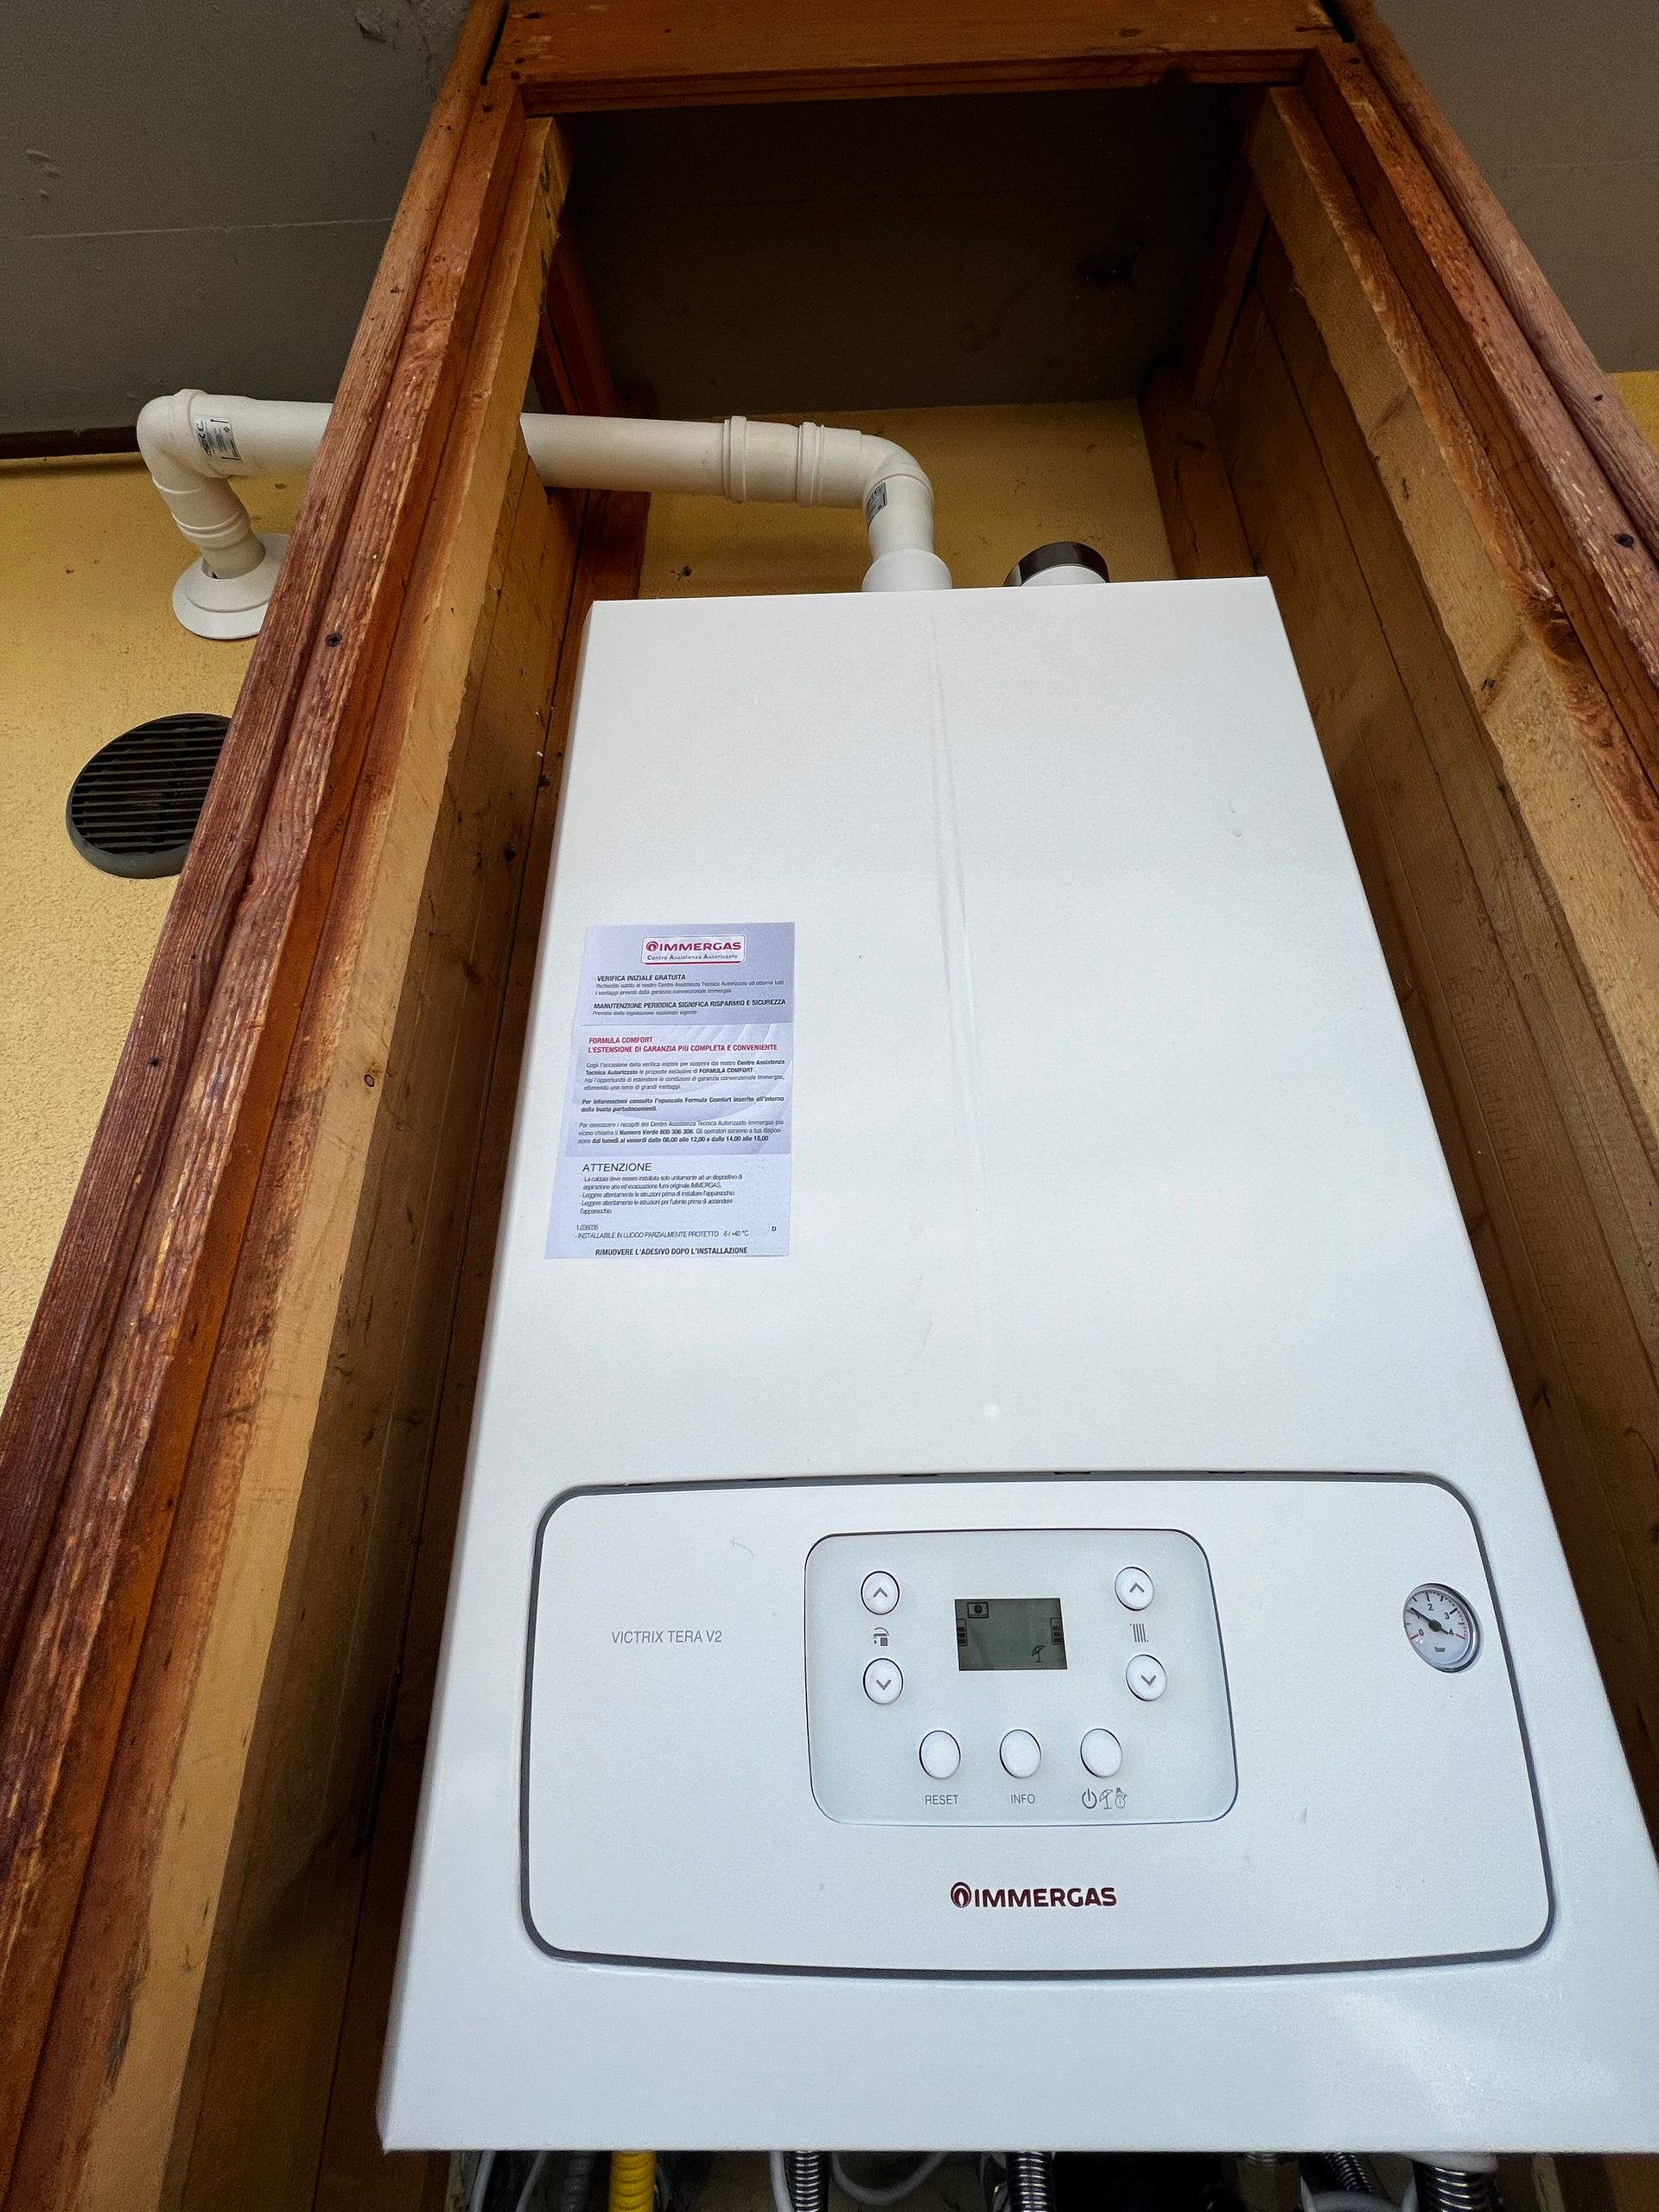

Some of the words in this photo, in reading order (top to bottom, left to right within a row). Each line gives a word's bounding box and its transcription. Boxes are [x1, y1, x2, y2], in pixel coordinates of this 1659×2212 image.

[659, 942, 741, 950] IMMERGAS
[582, 1163, 652, 1172] ATTENZIONE
[612, 1630, 664, 1643] VICTRIX
[668, 1630, 702, 1643] TERA
[706, 1630, 722, 1643] V2
[925, 1795, 959, 1804] RESET
[1011, 1794, 1036, 1804] INFO
[975, 1888, 1116, 1907] IMMERGAS
